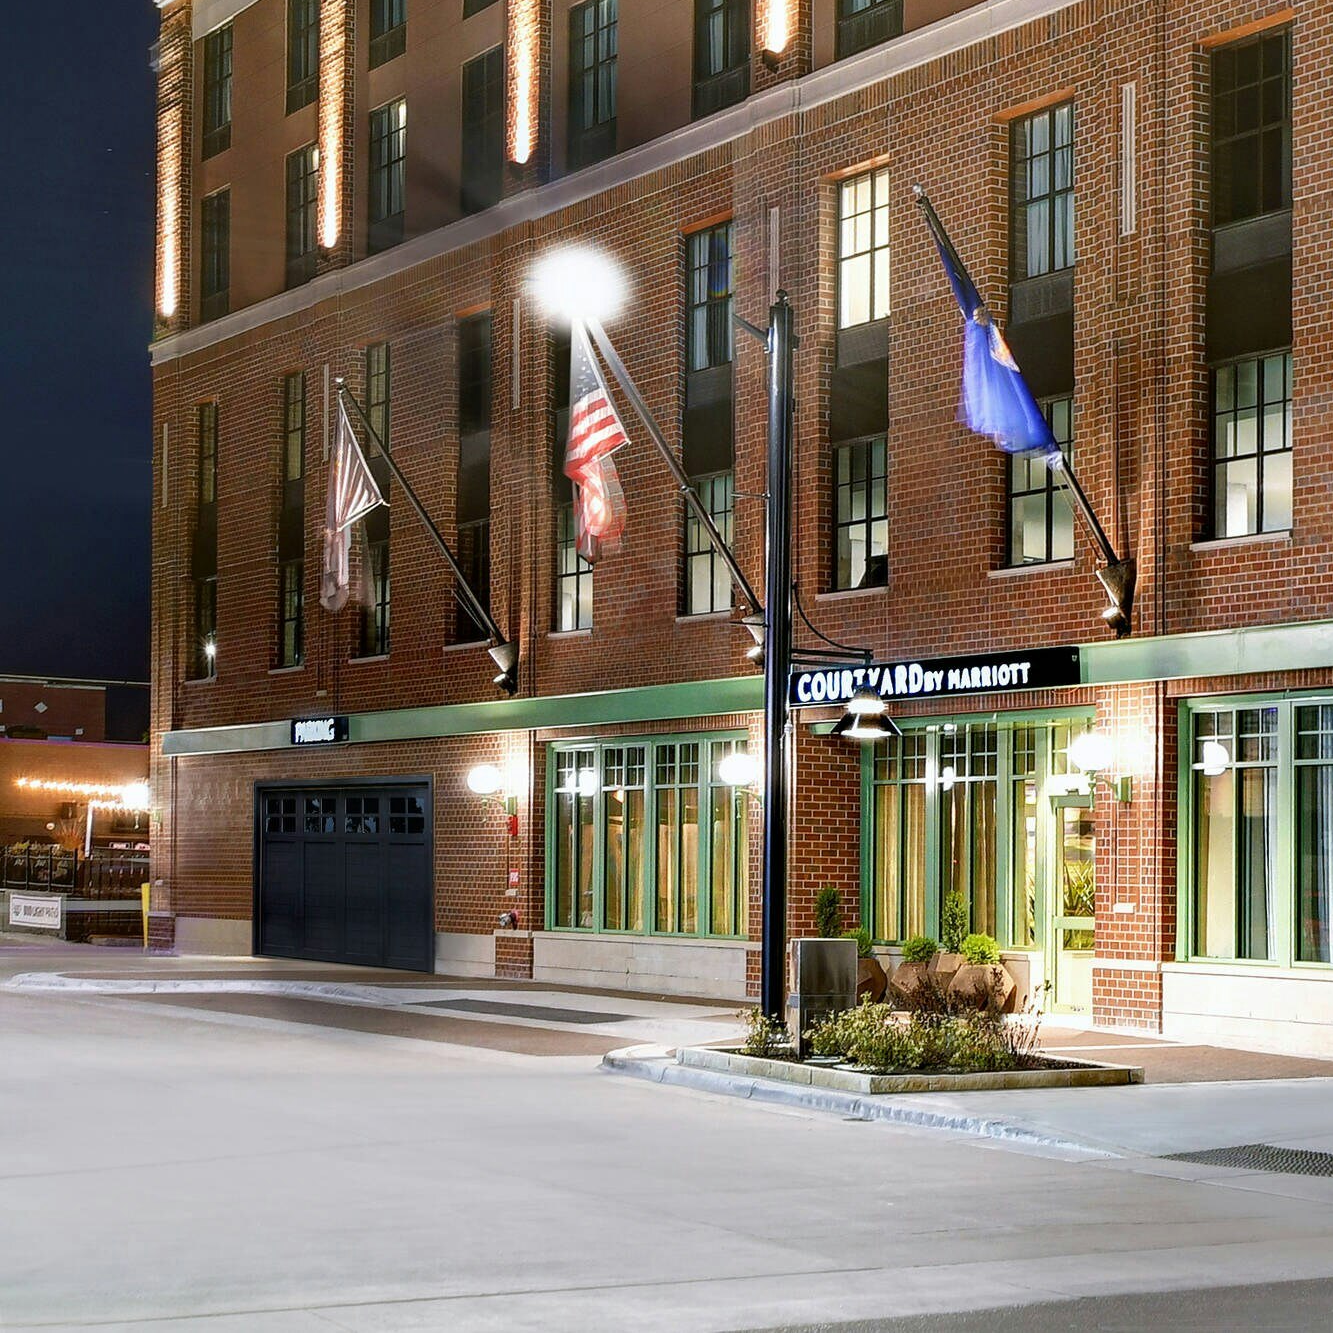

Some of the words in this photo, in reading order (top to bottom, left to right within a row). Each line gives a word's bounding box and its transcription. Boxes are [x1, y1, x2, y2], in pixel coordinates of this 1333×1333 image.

[798, 663, 922, 703] COURTYARD
[923, 670, 942, 691] BY
[947, 662, 1031, 690] MARRIOTT
